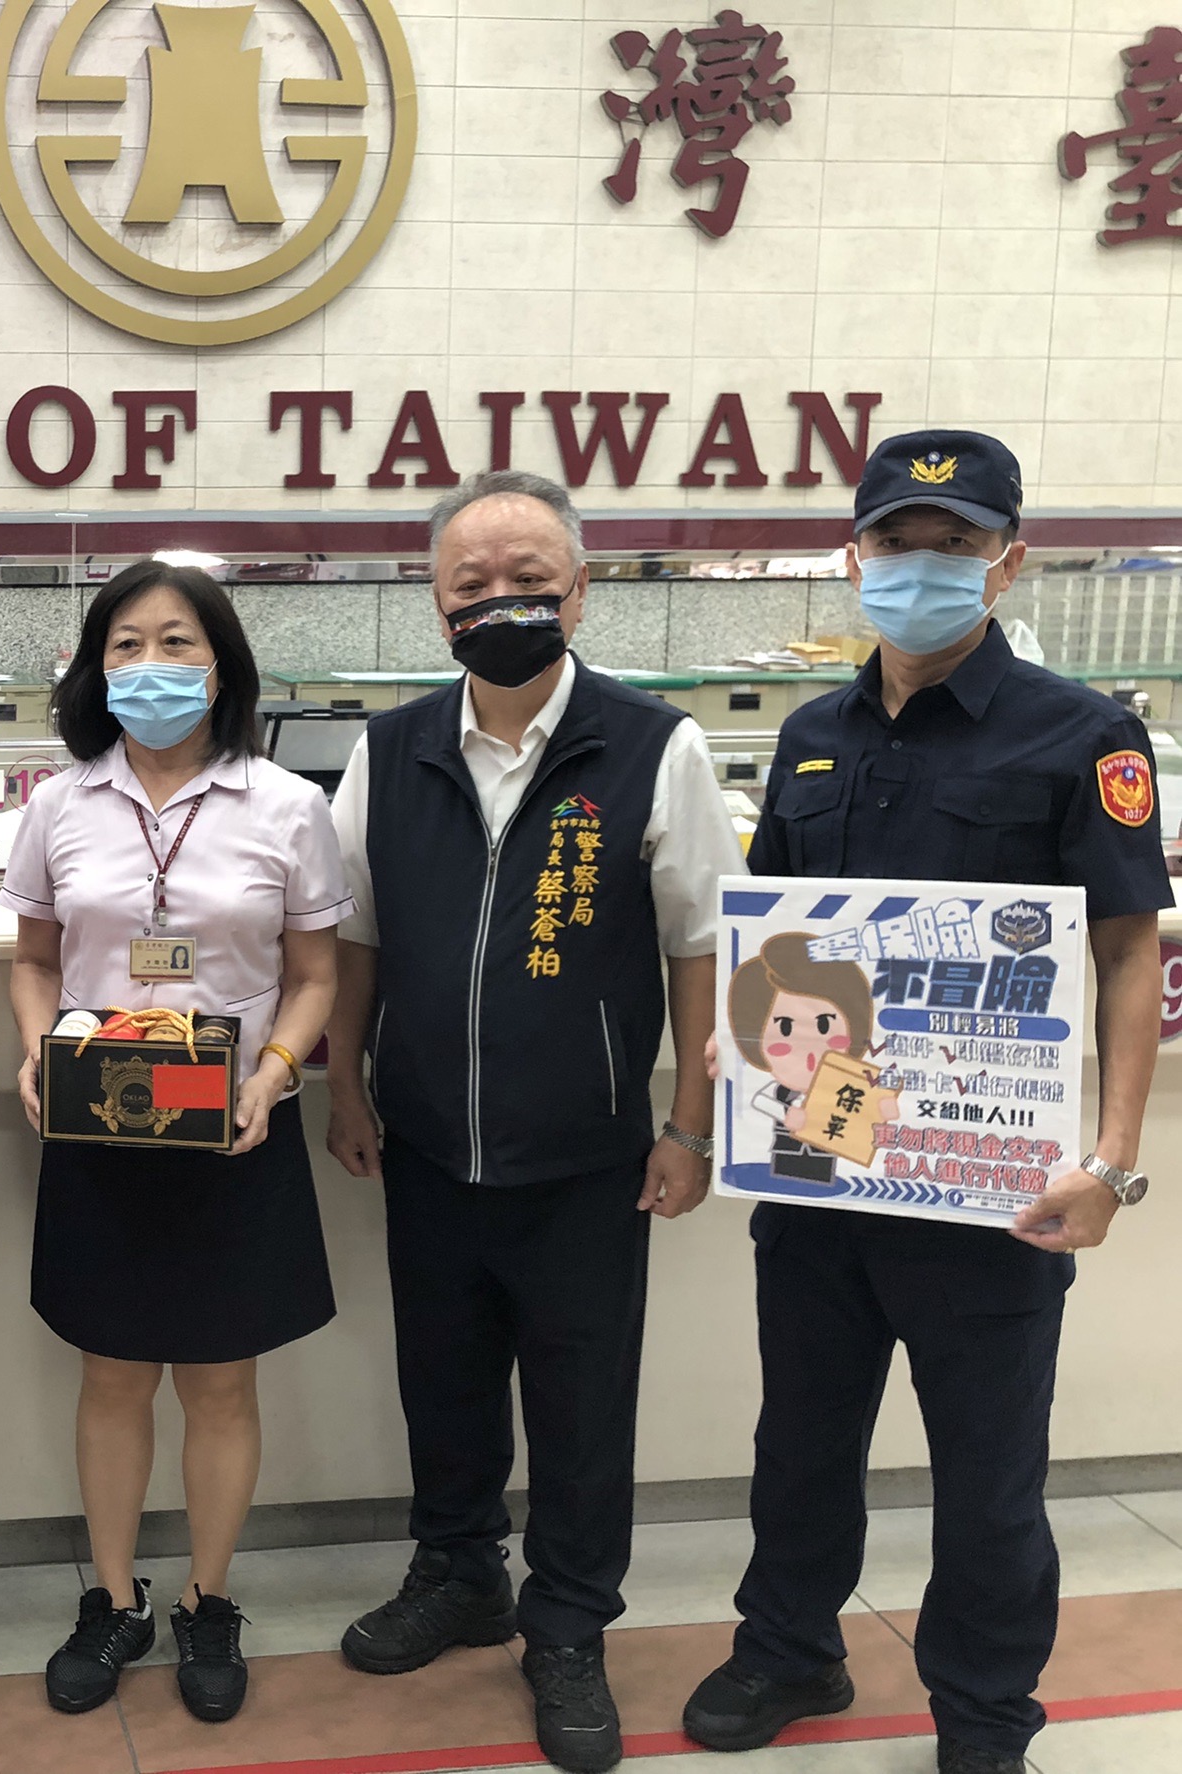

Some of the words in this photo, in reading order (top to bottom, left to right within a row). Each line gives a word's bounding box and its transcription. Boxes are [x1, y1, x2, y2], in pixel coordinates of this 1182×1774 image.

[7, 386, 197, 489] OF
[271, 391, 882, 488] TAIWAN
[569, 831, 604, 927] 警察局
[872, 954, 1059, 1015] 不冒險
[929, 1013, 1020, 1037] 別輕易將
